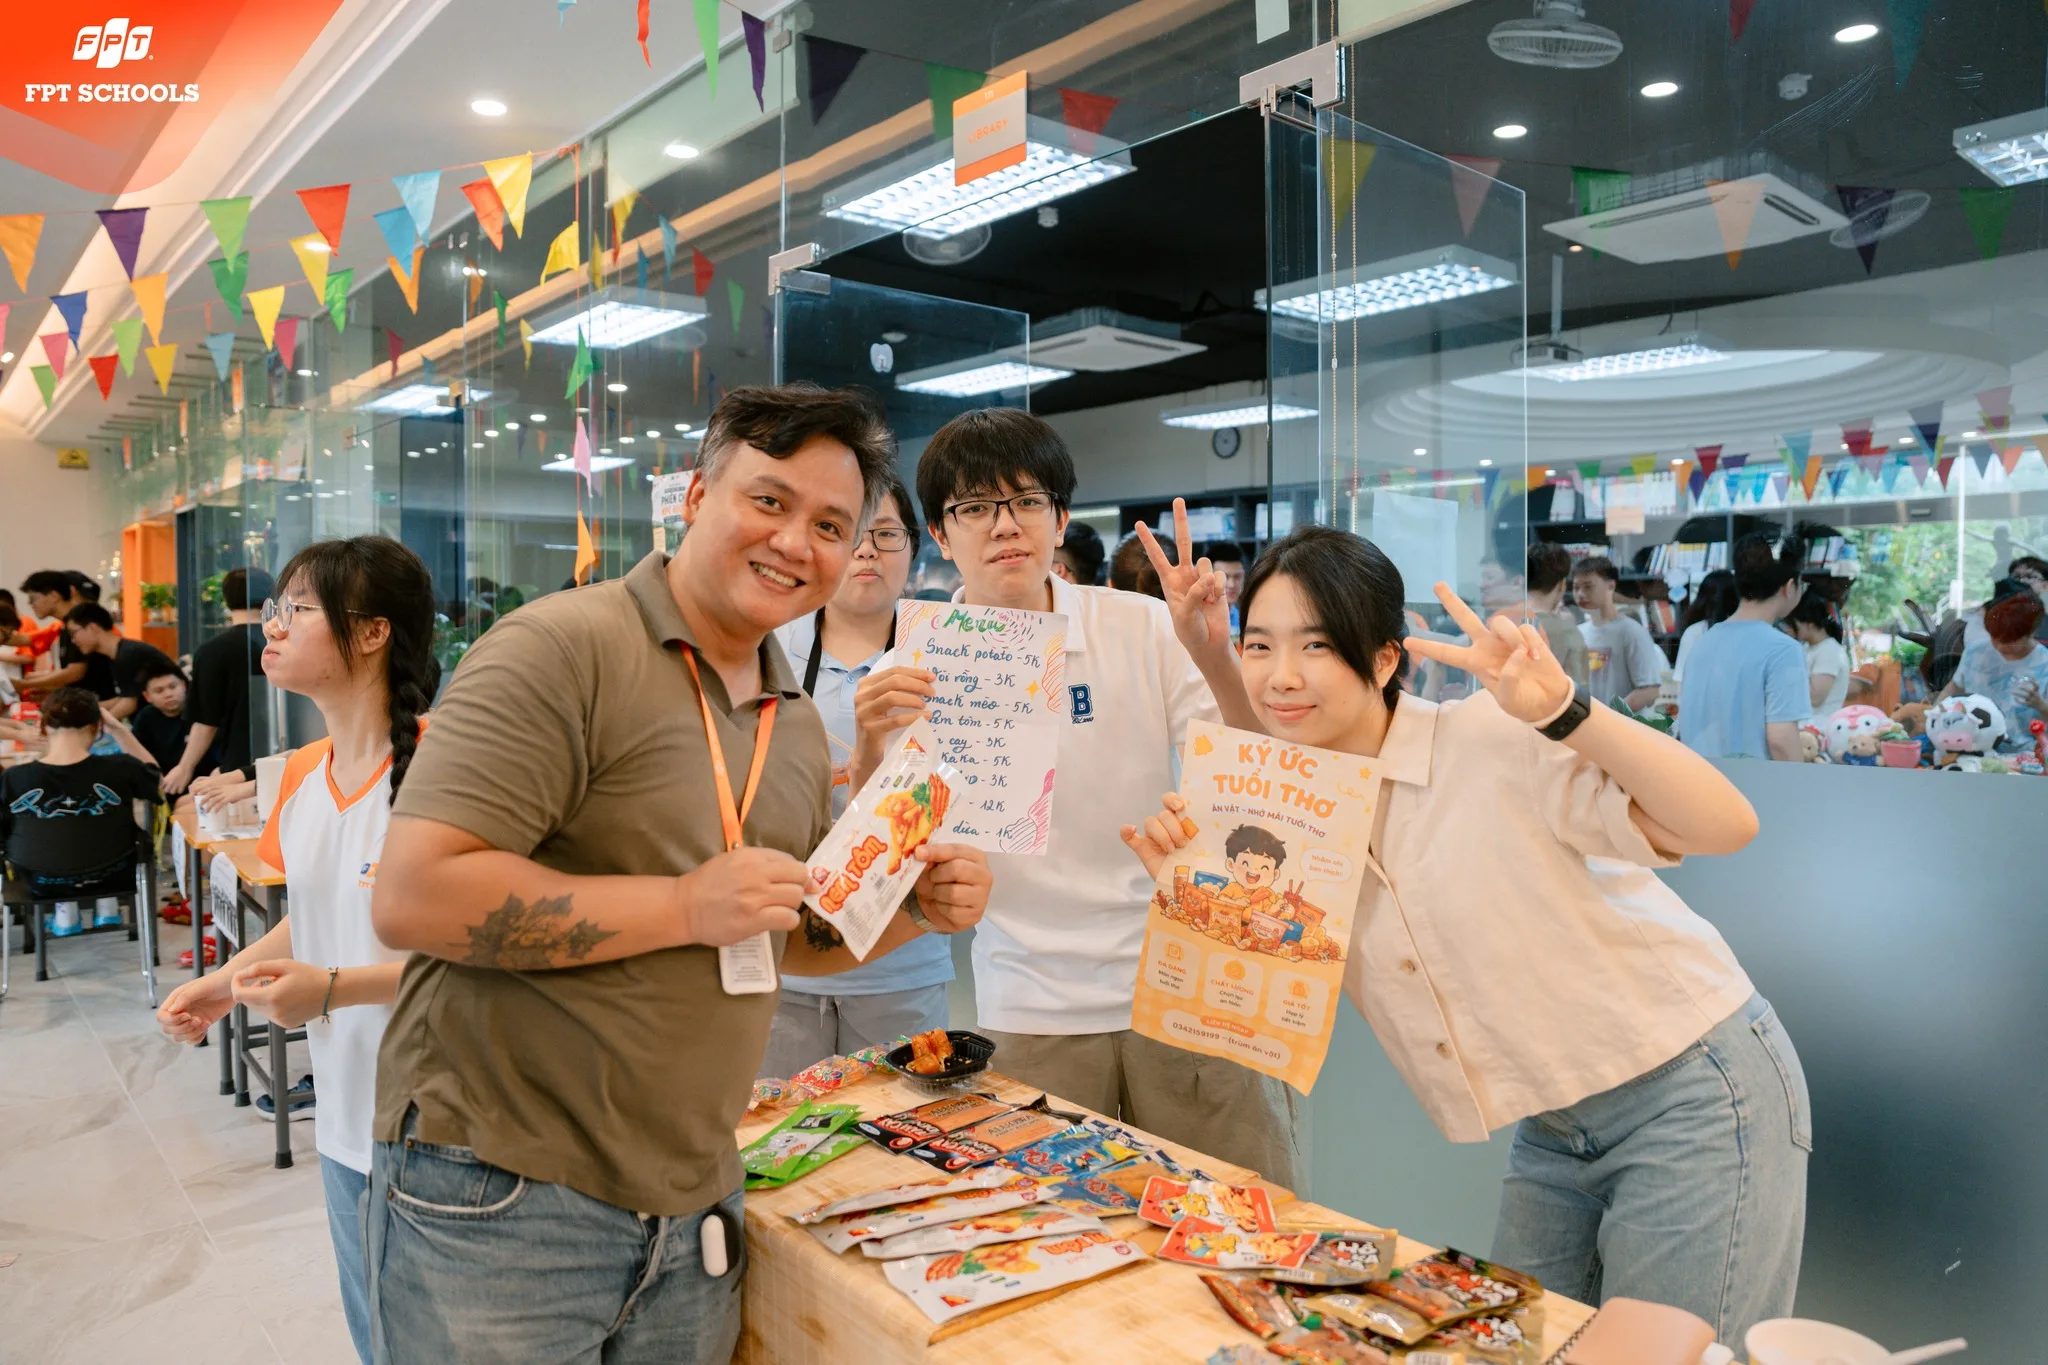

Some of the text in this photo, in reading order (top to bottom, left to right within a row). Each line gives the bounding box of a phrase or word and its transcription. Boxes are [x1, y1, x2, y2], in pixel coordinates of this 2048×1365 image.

[967, 119, 1007, 143] LIBRARY
[943, 608, 1006, 632] Menu
[974, 647, 1013, 662] potato
[1068, 683, 1093, 717] B
[958, 716, 982, 728] tôm
[949, 737, 973, 753] cay
[1238, 739, 1318, 779] KÝ ỨC
[1212, 769, 1337, 819] TUỔI THƠ
[1308, 825, 1326, 838] THƠ
[1173, 1022, 1220, 1040] 0342159199
